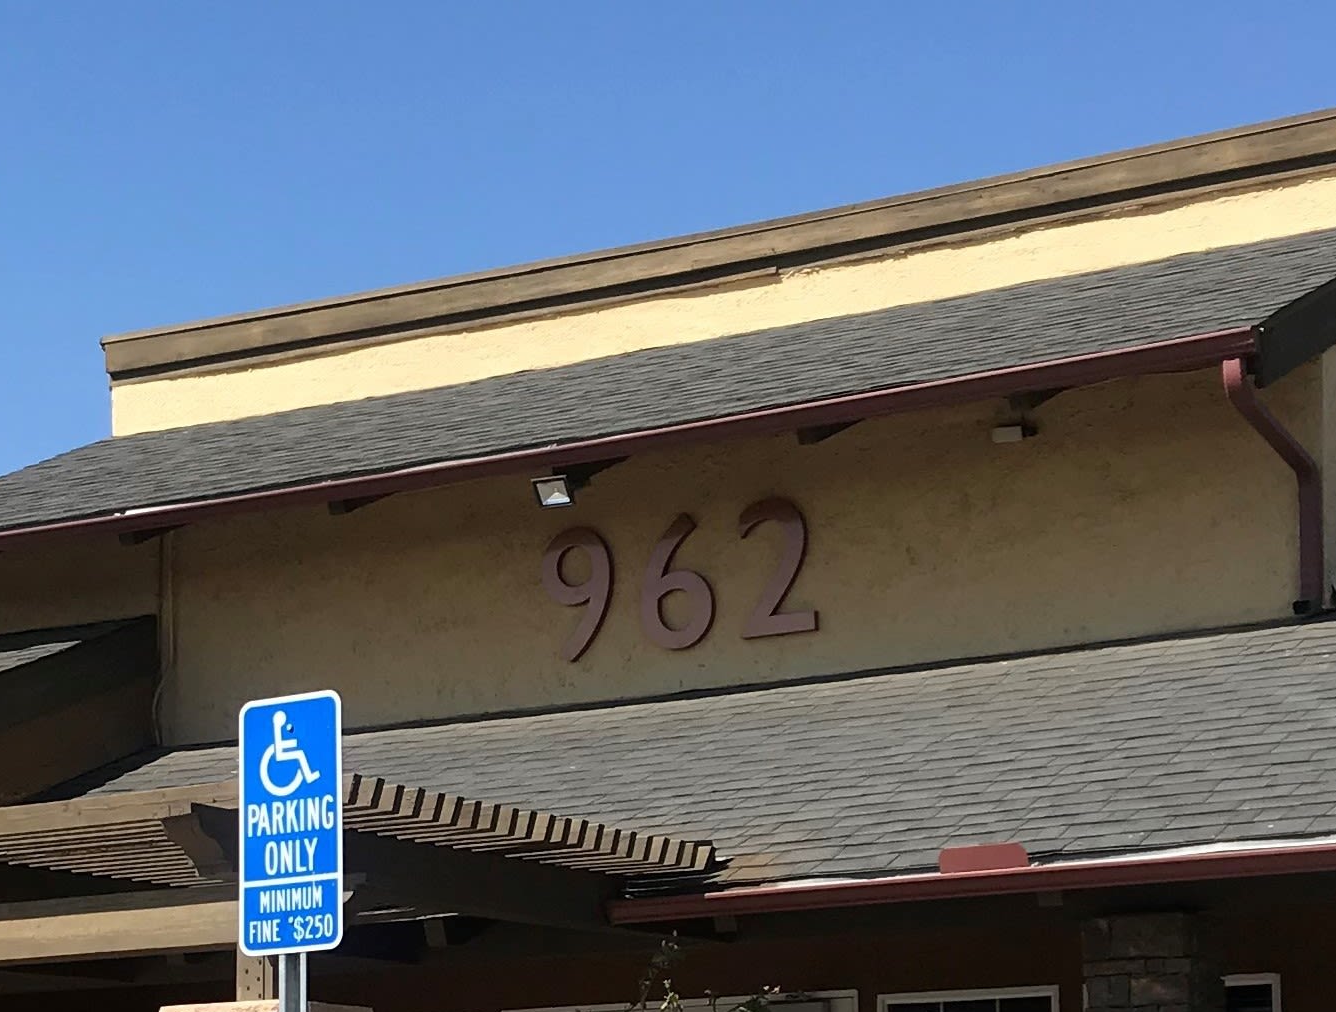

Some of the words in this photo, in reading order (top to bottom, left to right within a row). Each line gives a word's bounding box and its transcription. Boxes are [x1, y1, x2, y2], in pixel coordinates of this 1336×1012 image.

[541, 495, 819, 662] 962
[247, 794, 334, 837] PARKING
[265, 837, 318, 875] ONLY
[259, 885, 322, 914] MINIMUM
[249, 919, 281, 944] FINE
[293, 913, 333, 943] $250
